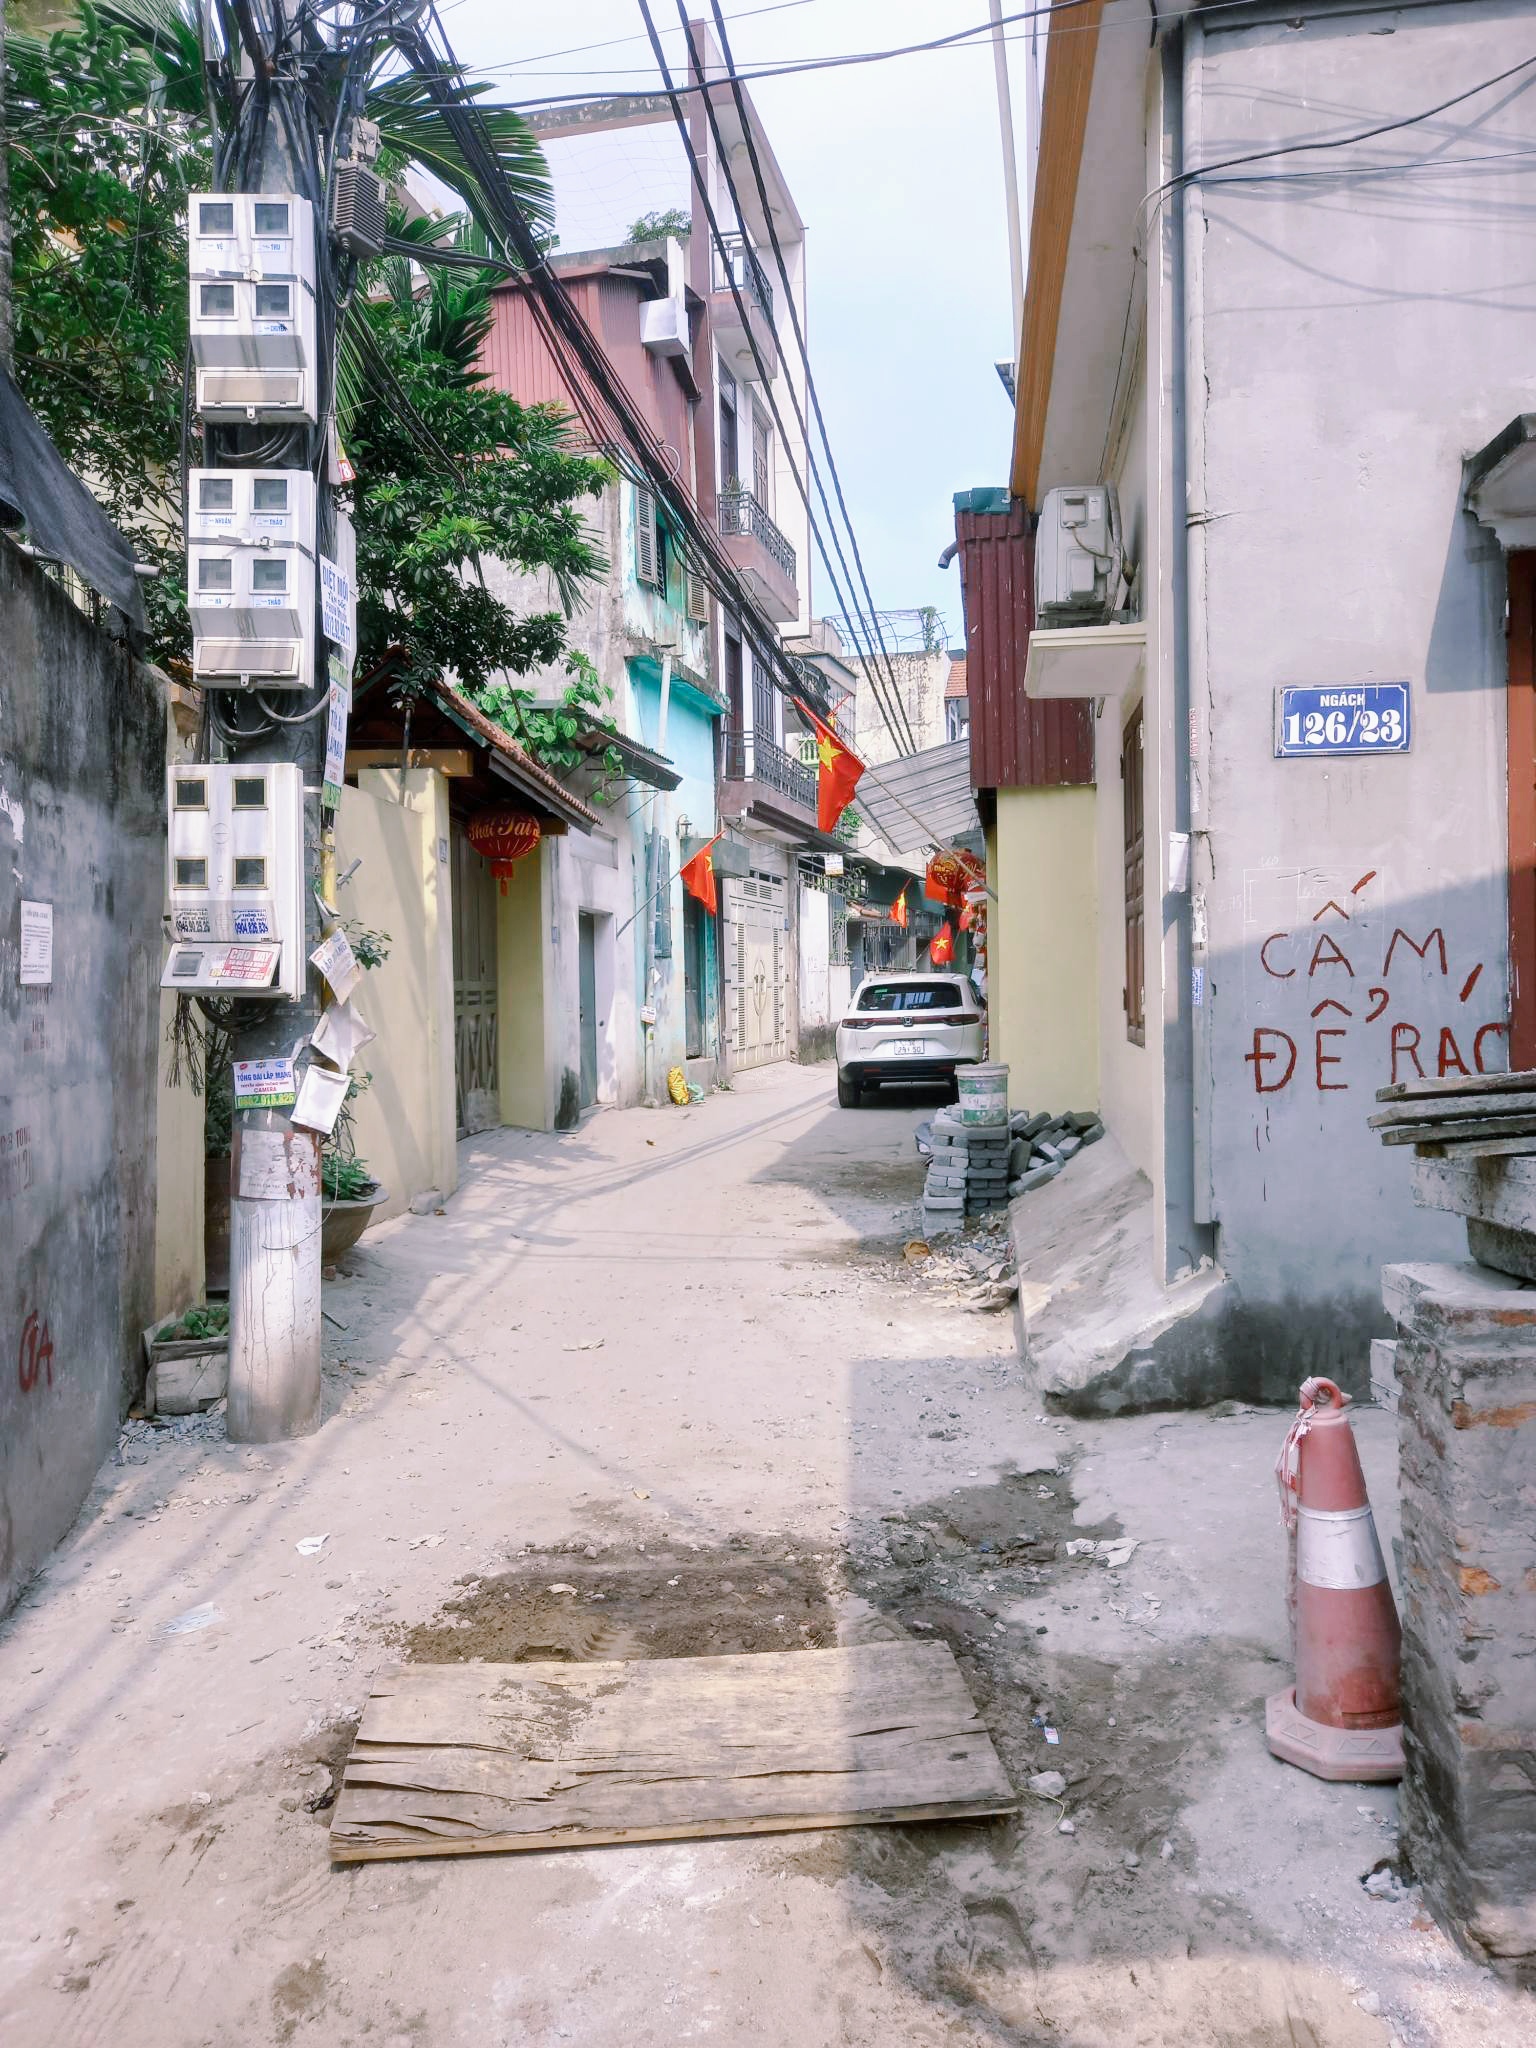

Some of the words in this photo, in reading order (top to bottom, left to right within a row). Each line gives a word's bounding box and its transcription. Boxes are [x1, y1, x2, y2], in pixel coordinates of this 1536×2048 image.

[1320, 692, 1366, 708] NGÁCH
[1284, 708, 1403, 746] 126/23
[1260, 870, 1448, 978] CẤM
